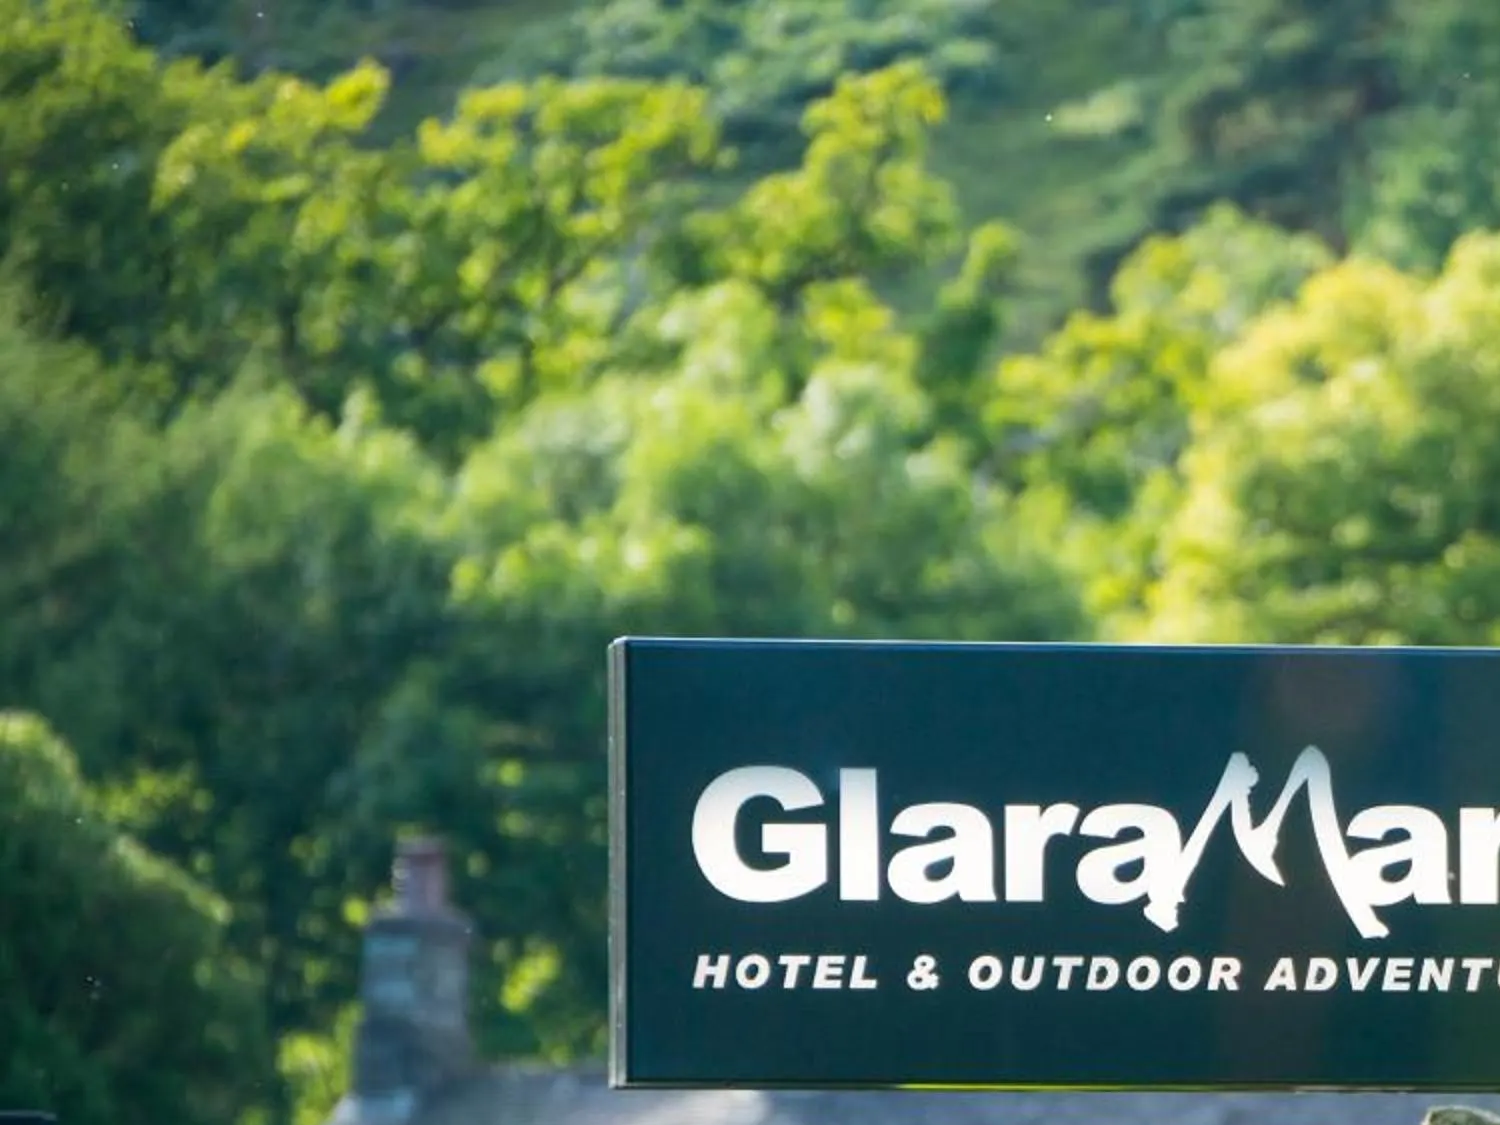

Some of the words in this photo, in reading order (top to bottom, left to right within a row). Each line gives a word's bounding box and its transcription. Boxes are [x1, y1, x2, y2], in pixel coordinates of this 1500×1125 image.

[692, 953, 878, 991] HOTEL
[905, 953, 940, 991] &
[967, 954, 1242, 993] OUTDOOR
